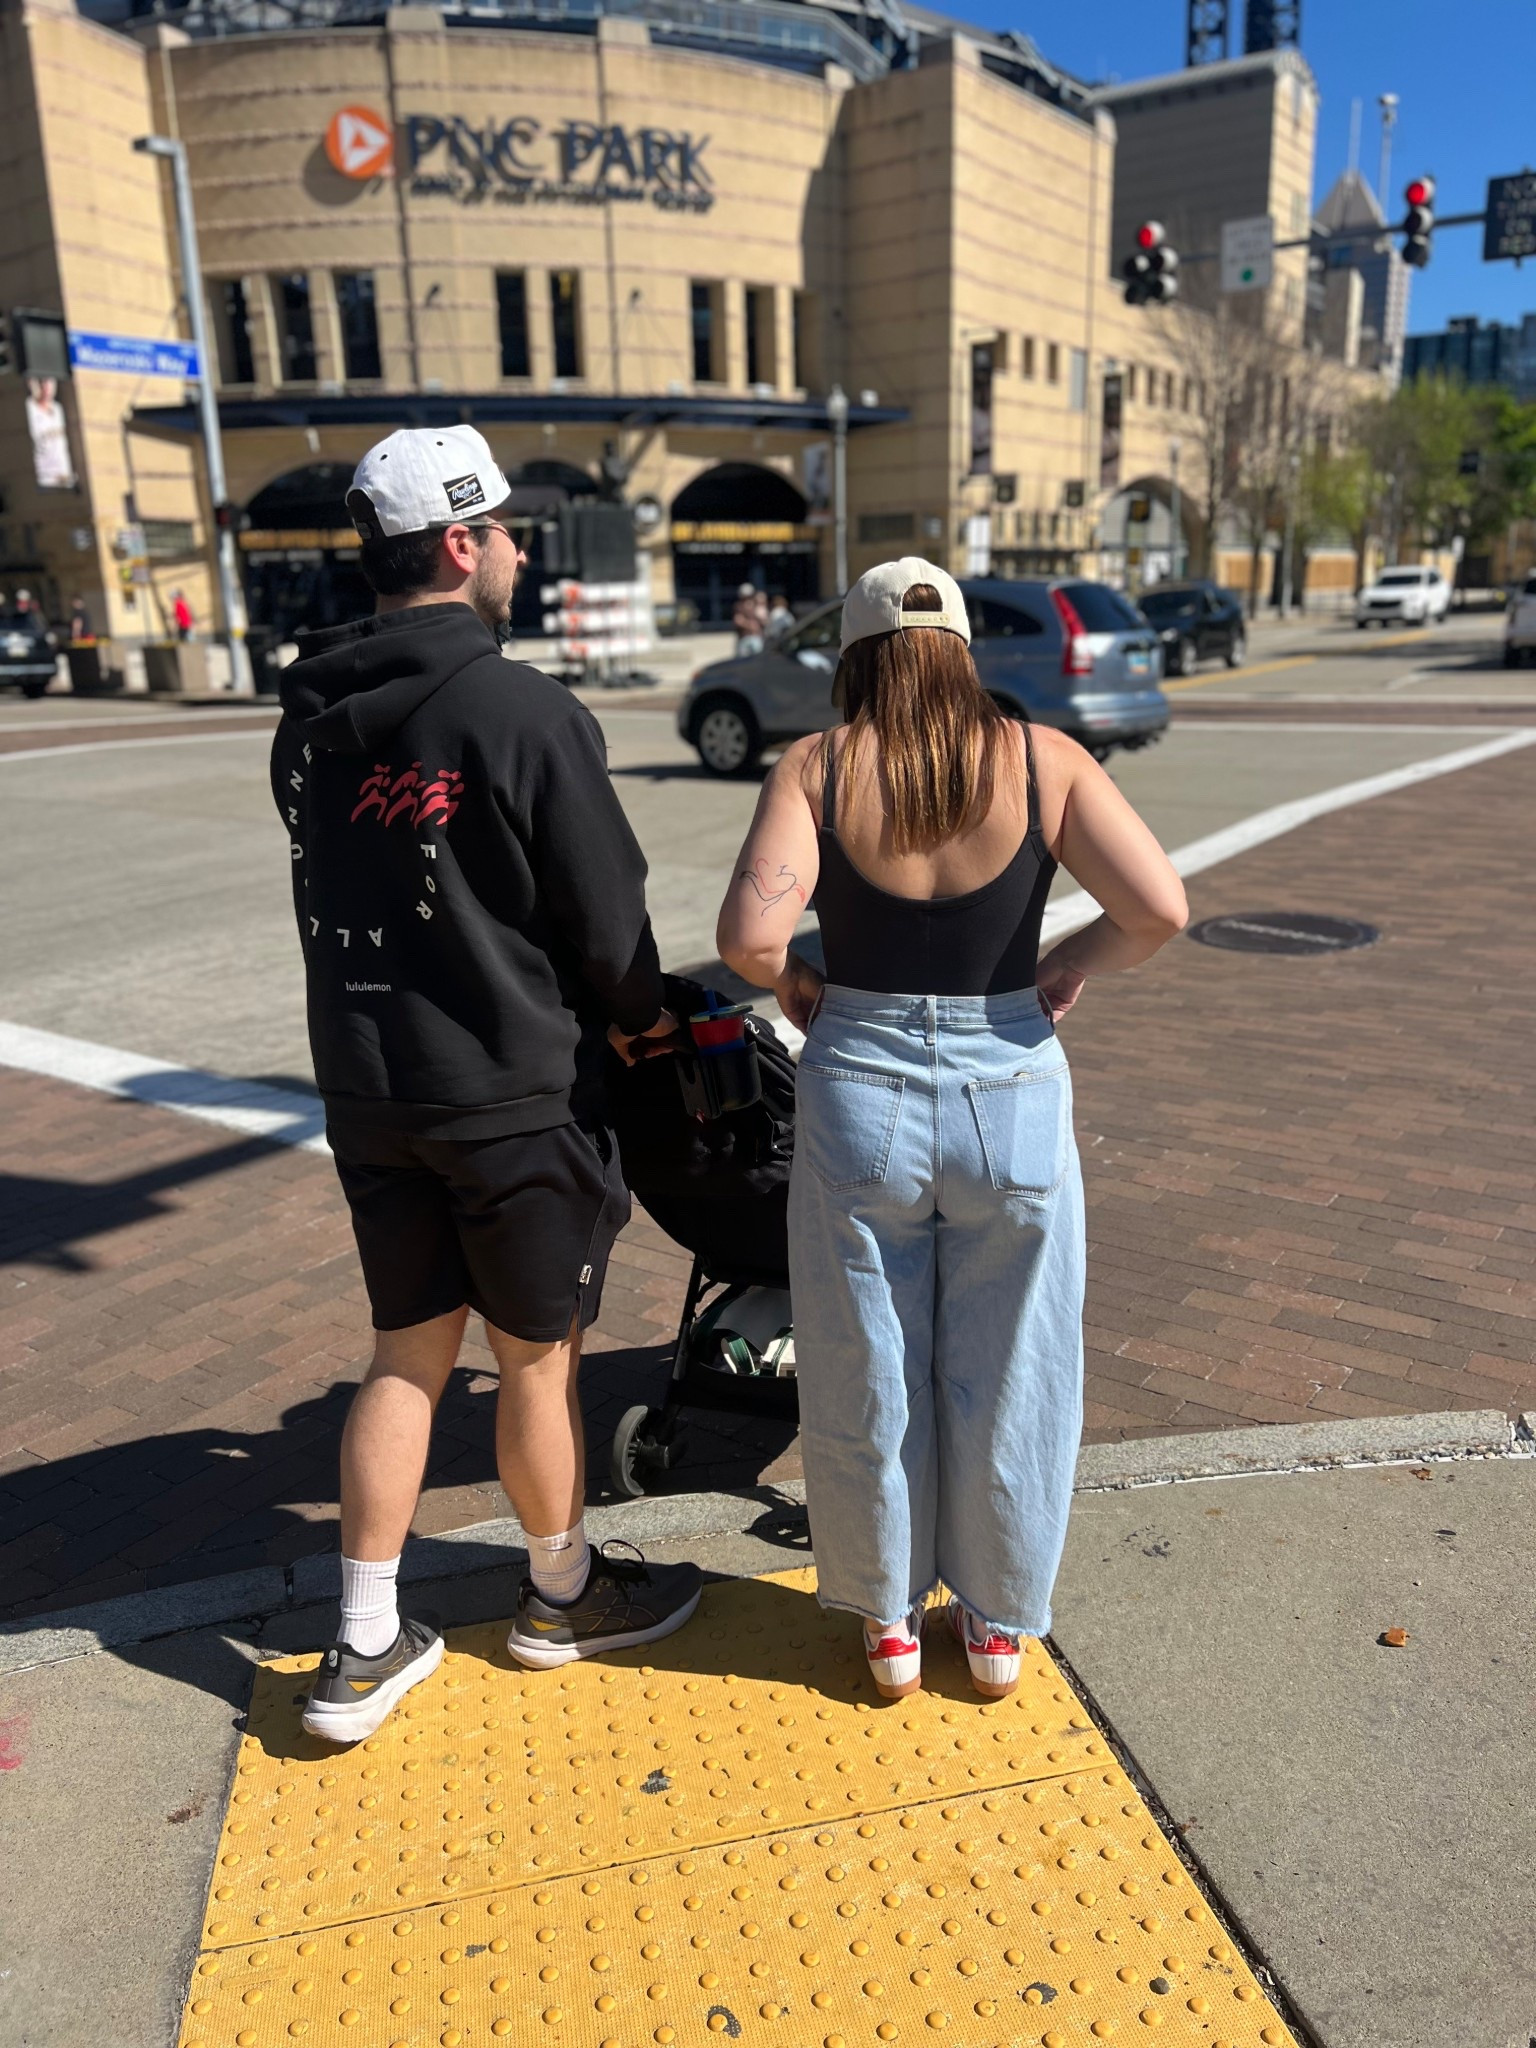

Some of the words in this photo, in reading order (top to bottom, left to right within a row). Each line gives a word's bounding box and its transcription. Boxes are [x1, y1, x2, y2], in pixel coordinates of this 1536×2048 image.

[403, 113, 543, 180] PNC
[557, 118, 715, 187] PARK
[416, 843, 437, 921] FOR
[309, 916, 383, 948] ALL
[345, 981, 392, 992] lululemon
